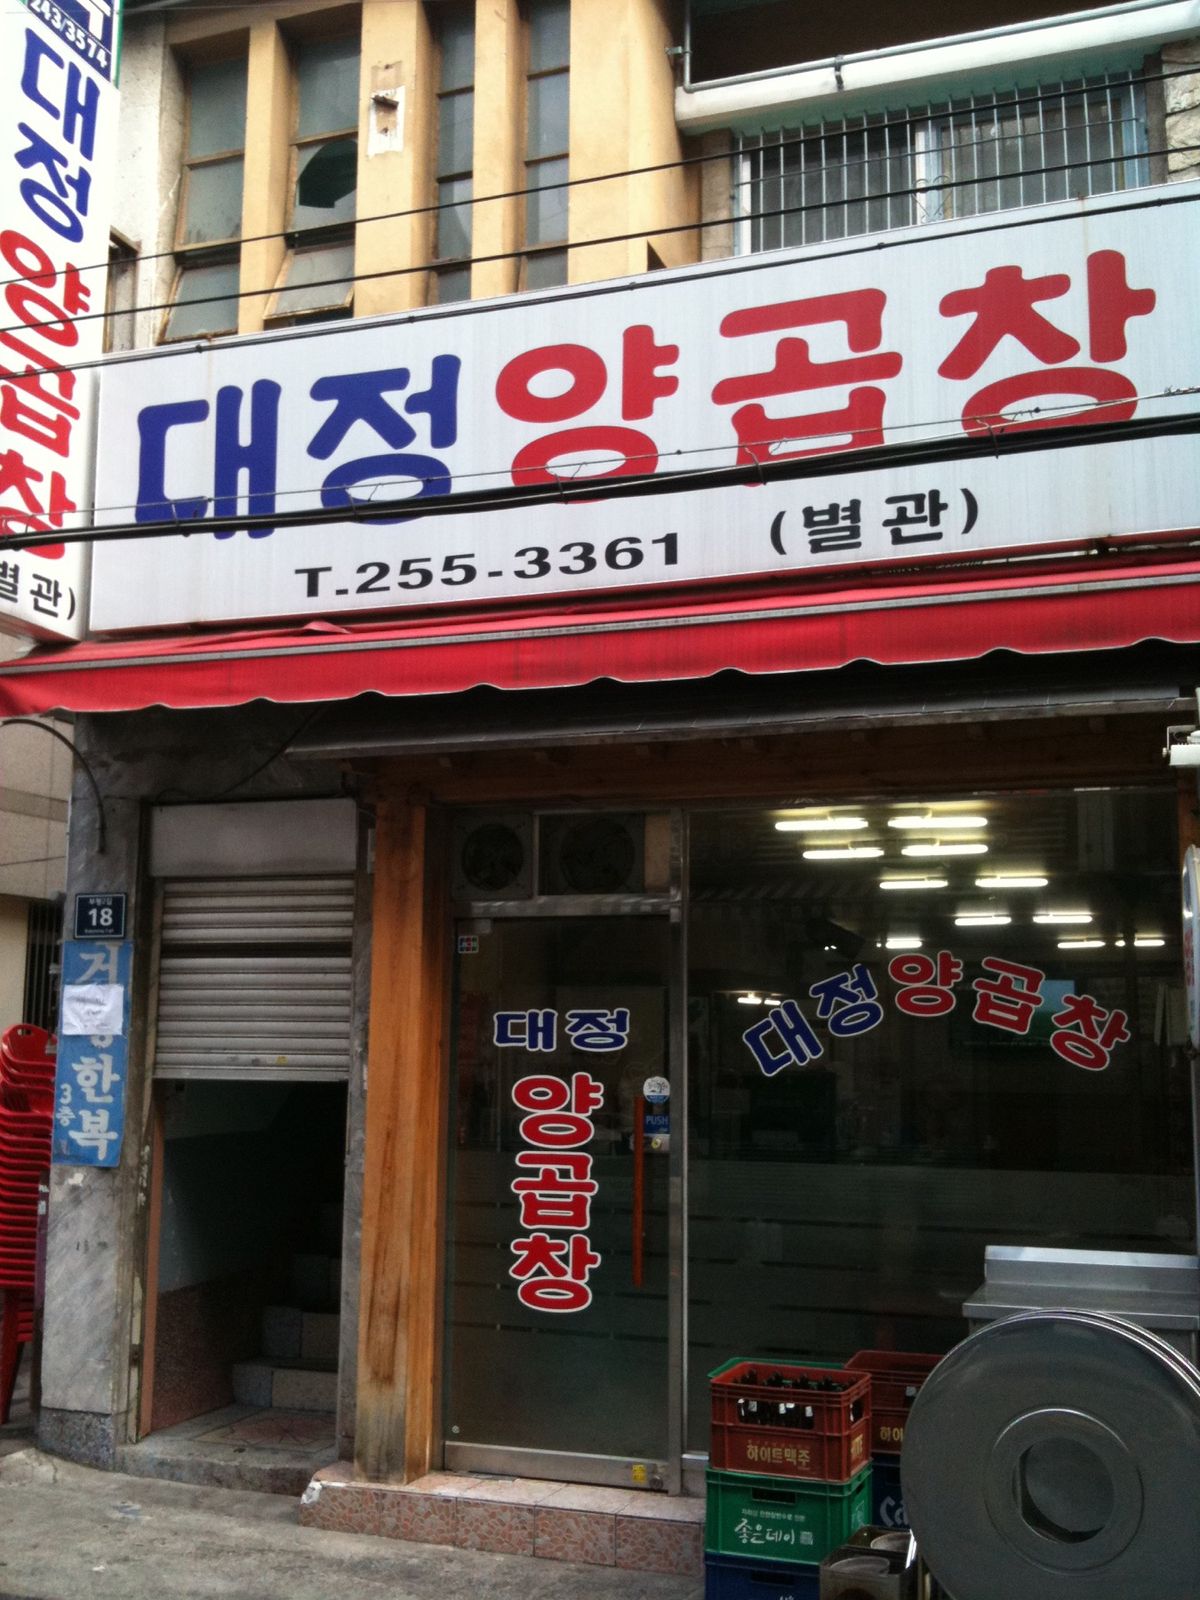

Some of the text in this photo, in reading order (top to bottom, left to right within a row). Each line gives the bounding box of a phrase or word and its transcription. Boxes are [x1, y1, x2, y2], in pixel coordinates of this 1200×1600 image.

[771, 488, 979, 555] (별관)
[88, 908, 113, 926] 18
[493, 1009, 630, 1052] 대정
[56, 1083, 76, 1127] 3층
[646, 1115, 669, 1125] PUSH
[508, 1071, 603, 1313] 양곱창
[746, 1444, 811, 1467] 하이트맥주
[734, 1518, 796, 1545] 좋은데이
